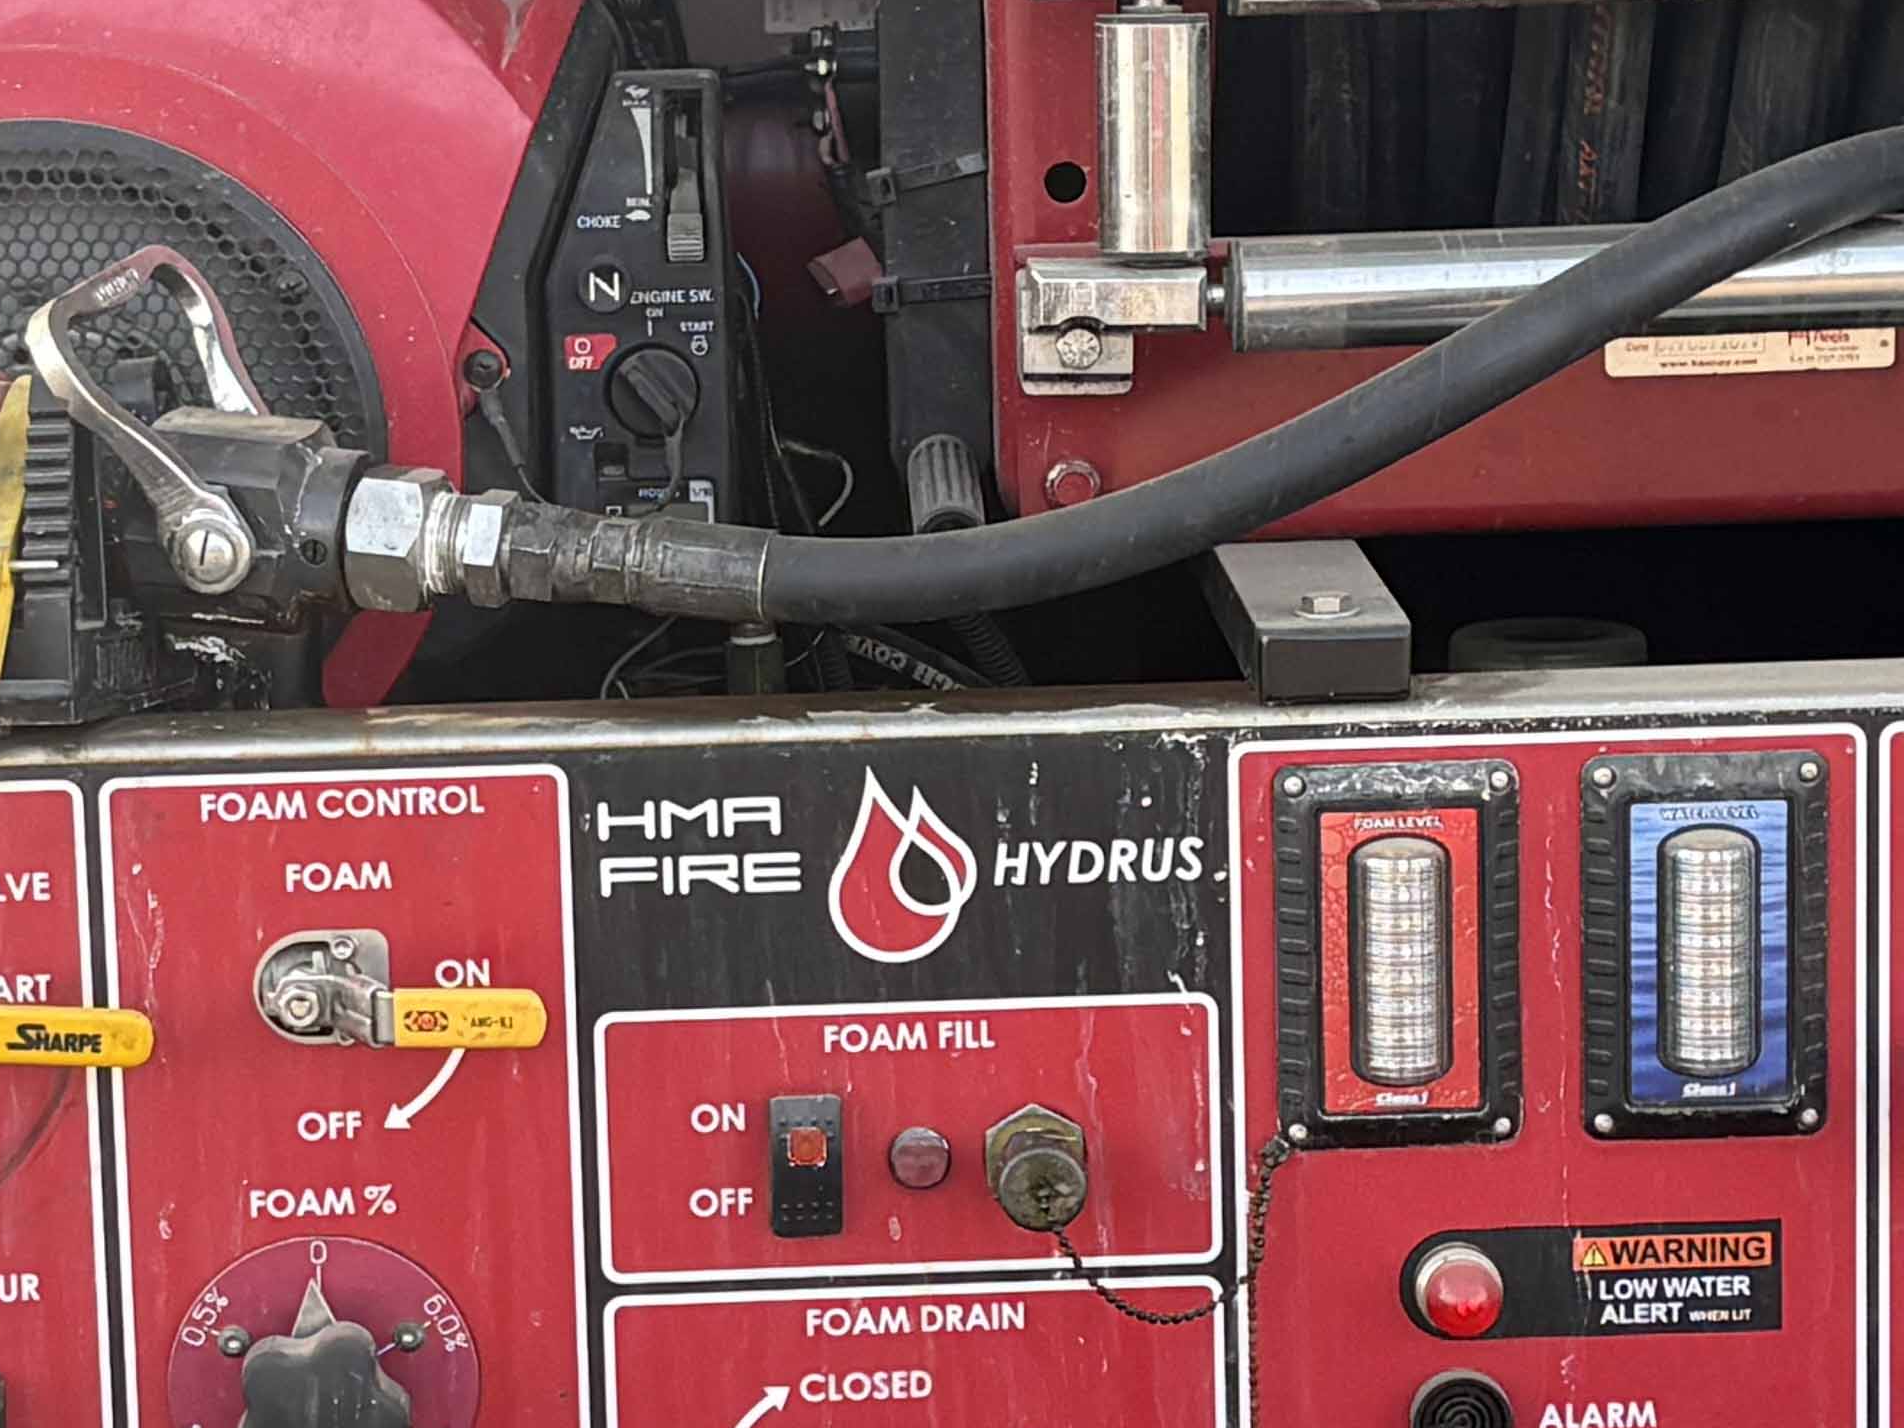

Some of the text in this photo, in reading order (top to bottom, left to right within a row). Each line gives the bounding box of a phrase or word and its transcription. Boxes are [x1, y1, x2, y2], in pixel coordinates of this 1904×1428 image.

[577, 214, 621, 228] CHOKE
[630, 290, 686, 304] ENGINE
[568, 356, 594, 369] OFF
[200, 785, 485, 823] FOAM CONTROL
[597, 795, 782, 841] HMA
[599, 851, 802, 897] FIRE
[993, 837, 1205, 886] HYDRUS
[284, 862, 392, 893] FOAM
[434, 959, 491, 988] ON
[822, 1020, 995, 1053] FOAM FILL
[297, 1111, 362, 1142] OFF
[690, 1102, 746, 1133] ON
[249, 1183, 397, 1219] FOAM %
[689, 1187, 753, 1217] OFF
[309, 1240, 328, 1265] 0
[1609, 1235, 1767, 1265] WARNING
[1599, 1275, 1751, 1301] LOW WATER
[181, 1286, 229, 1348] 0.5%
[423, 1293, 469, 1353] 6.0%
[805, 1301, 1027, 1338] FOAM DRAIN
[1600, 1302, 1752, 1325] ALERT WHEN LIT
[798, 1369, 933, 1404] CLOSED
